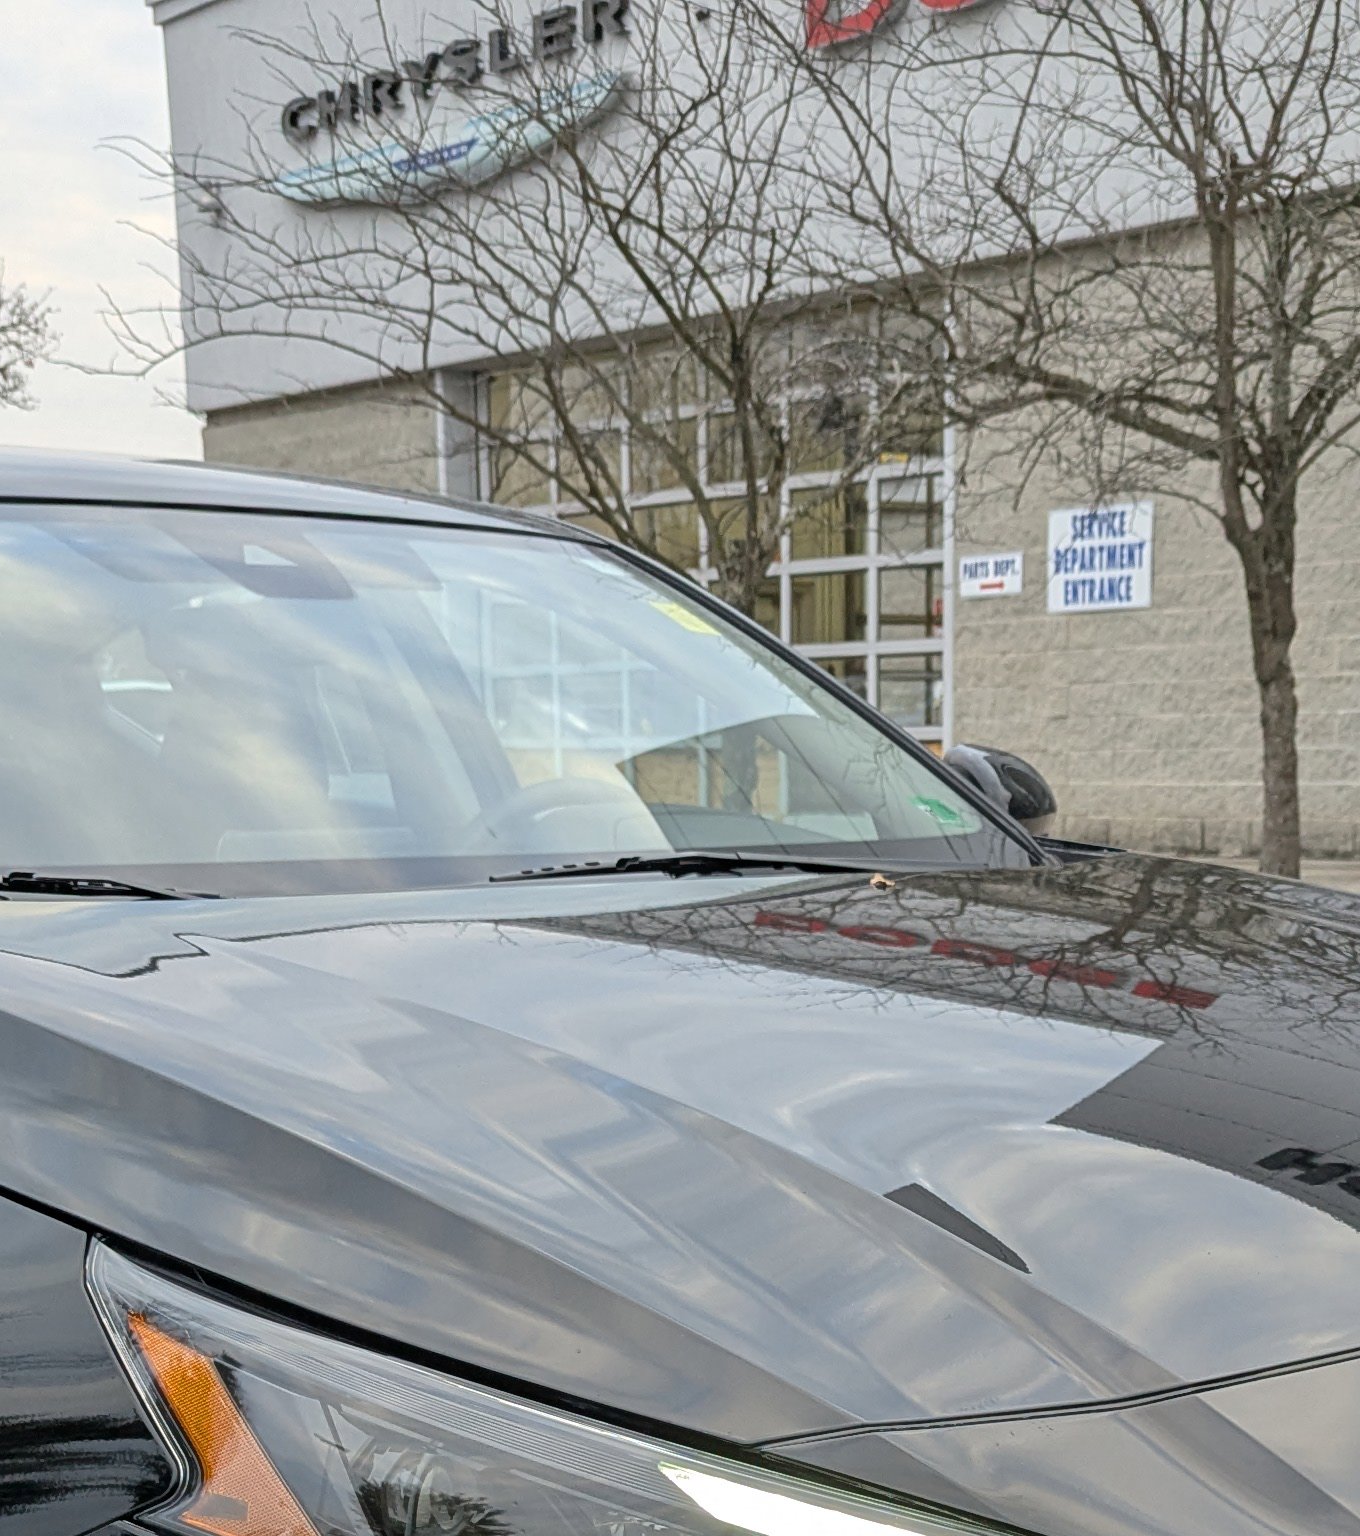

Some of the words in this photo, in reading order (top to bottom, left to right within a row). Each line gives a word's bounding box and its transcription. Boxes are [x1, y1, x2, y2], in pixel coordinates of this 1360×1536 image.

[282, 0, 630, 143] CHRYSLER
[1071, 511, 1127, 541] SERVICE
[962, 561, 990, 580] PARTS
[1054, 542, 1145, 575] DEPARTMENT
[1063, 575, 1133, 606] ENTRANCE
